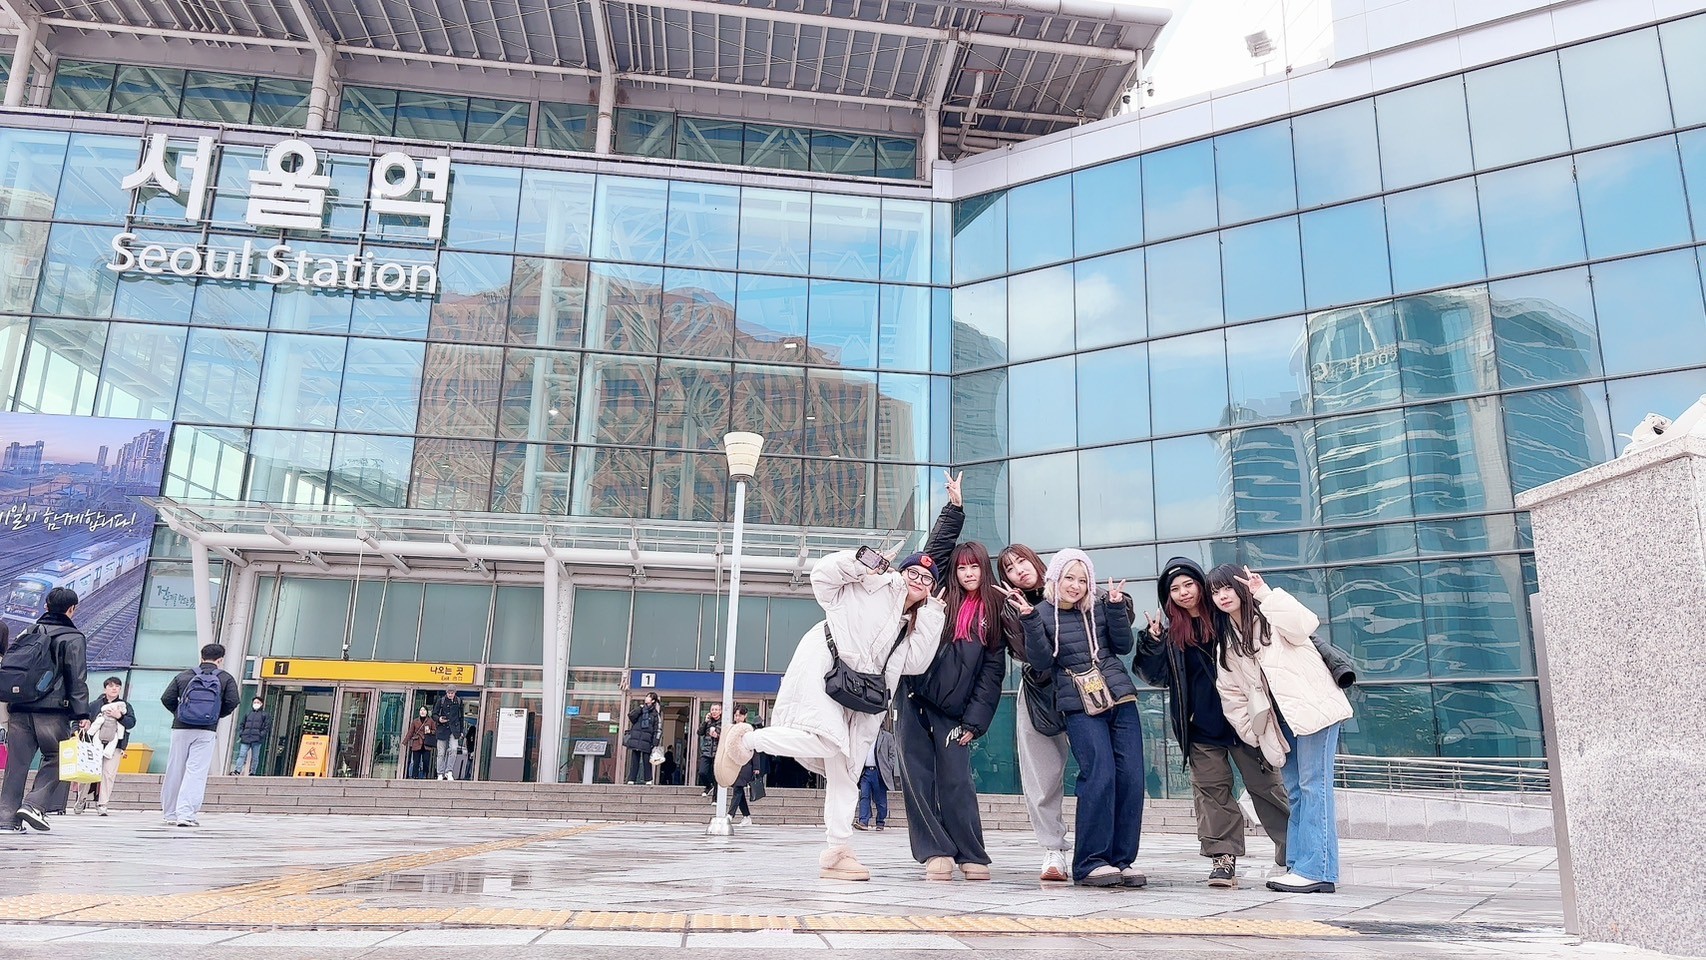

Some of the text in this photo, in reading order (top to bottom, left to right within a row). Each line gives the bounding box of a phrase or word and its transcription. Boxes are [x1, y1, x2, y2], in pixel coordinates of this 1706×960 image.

[121, 133, 452, 240] 서울역
[106, 232, 438, 295] Seoul Station
[43, 506, 137, 533] 함께합니다!
[430, 666, 464, 676] 나오는 곳
